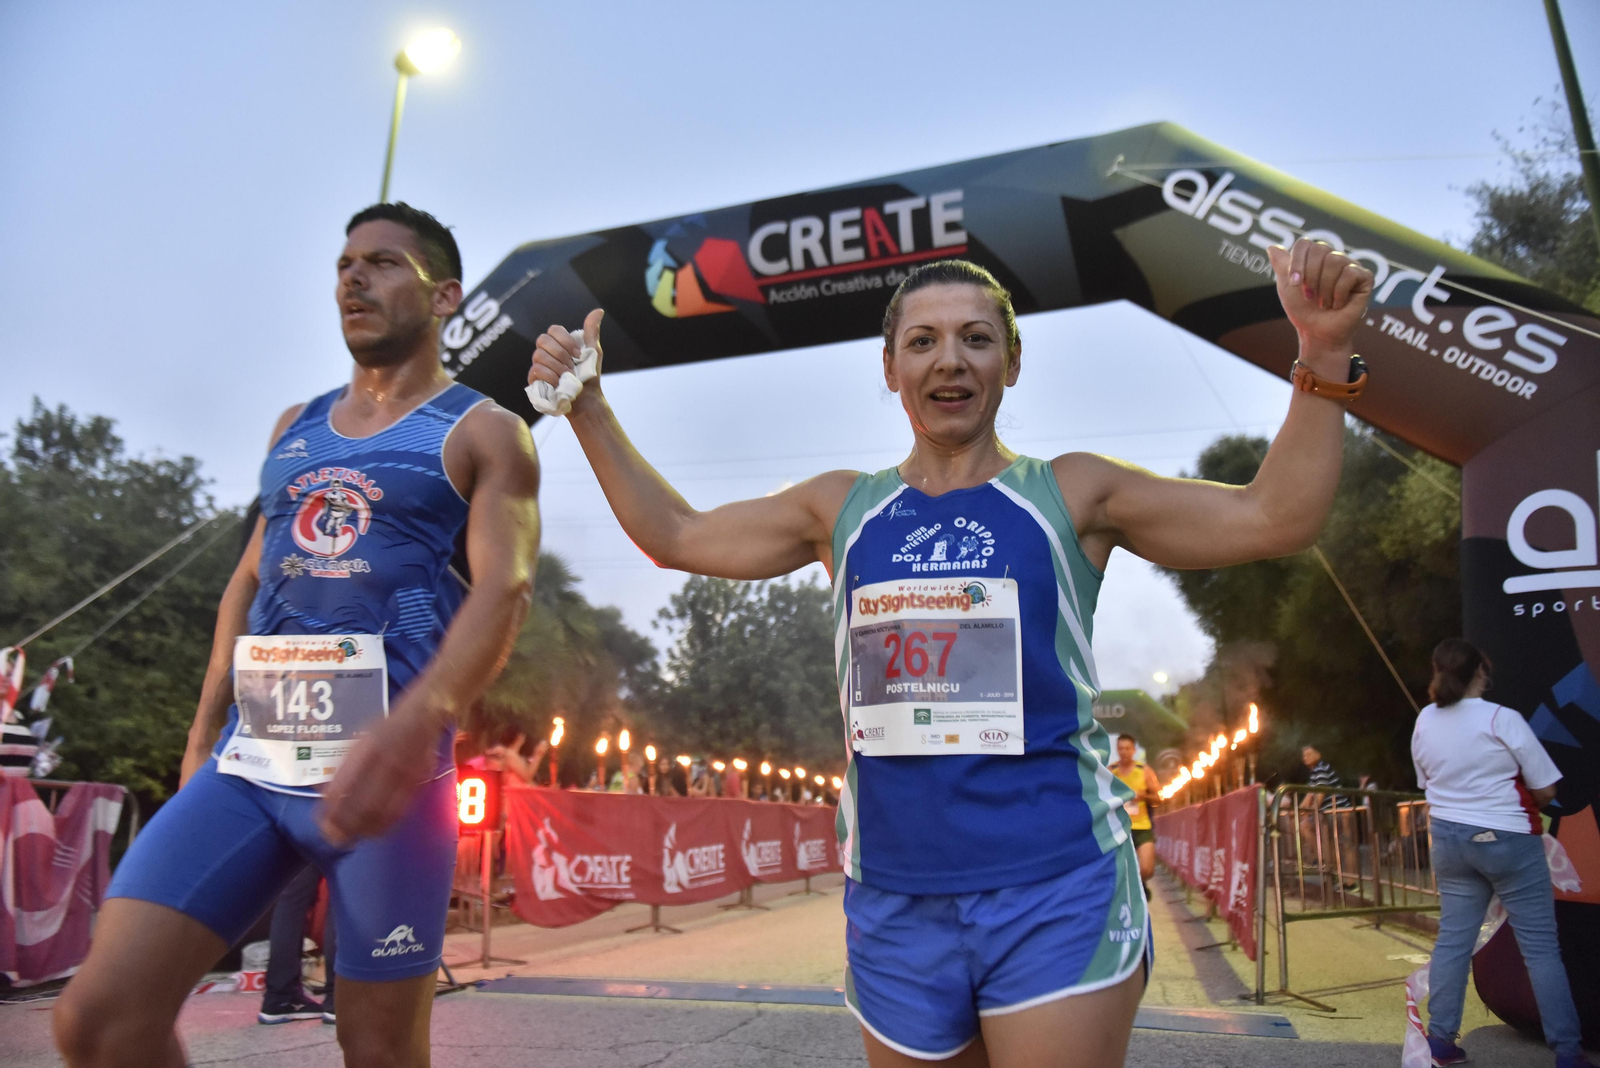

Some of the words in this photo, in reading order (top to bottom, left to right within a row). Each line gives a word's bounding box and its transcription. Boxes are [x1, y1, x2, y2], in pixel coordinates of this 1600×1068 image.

[748, 189, 968, 276] CREATE
[769, 284, 819, 305] Acción
[820, 274, 883, 296] Creativa
[1379, 314, 1431, 351] TRAIL
[1442, 346, 1538, 400] OUTDOOR
[286, 467, 384, 501] ATLETISMO
[900, 523, 942, 553] ATLETISMO
[906, 526, 928, 542] CLUB
[953, 517, 995, 557] ORIPPO
[892, 554, 922, 562] DOS
[912, 559, 988, 572] HERMANAS
[973, 622, 1004, 630] ALAMILLO
[884, 631, 958, 679] 267
[270, 680, 335, 720] 143
[886, 682, 960, 695] POSTELNICU
[267, 724, 295, 734] LOPEZ
[297, 724, 343, 734] FLORES
[984, 732, 1003, 740] KIA
[459, 778, 486, 824] 8
[371, 943, 425, 958] austral
